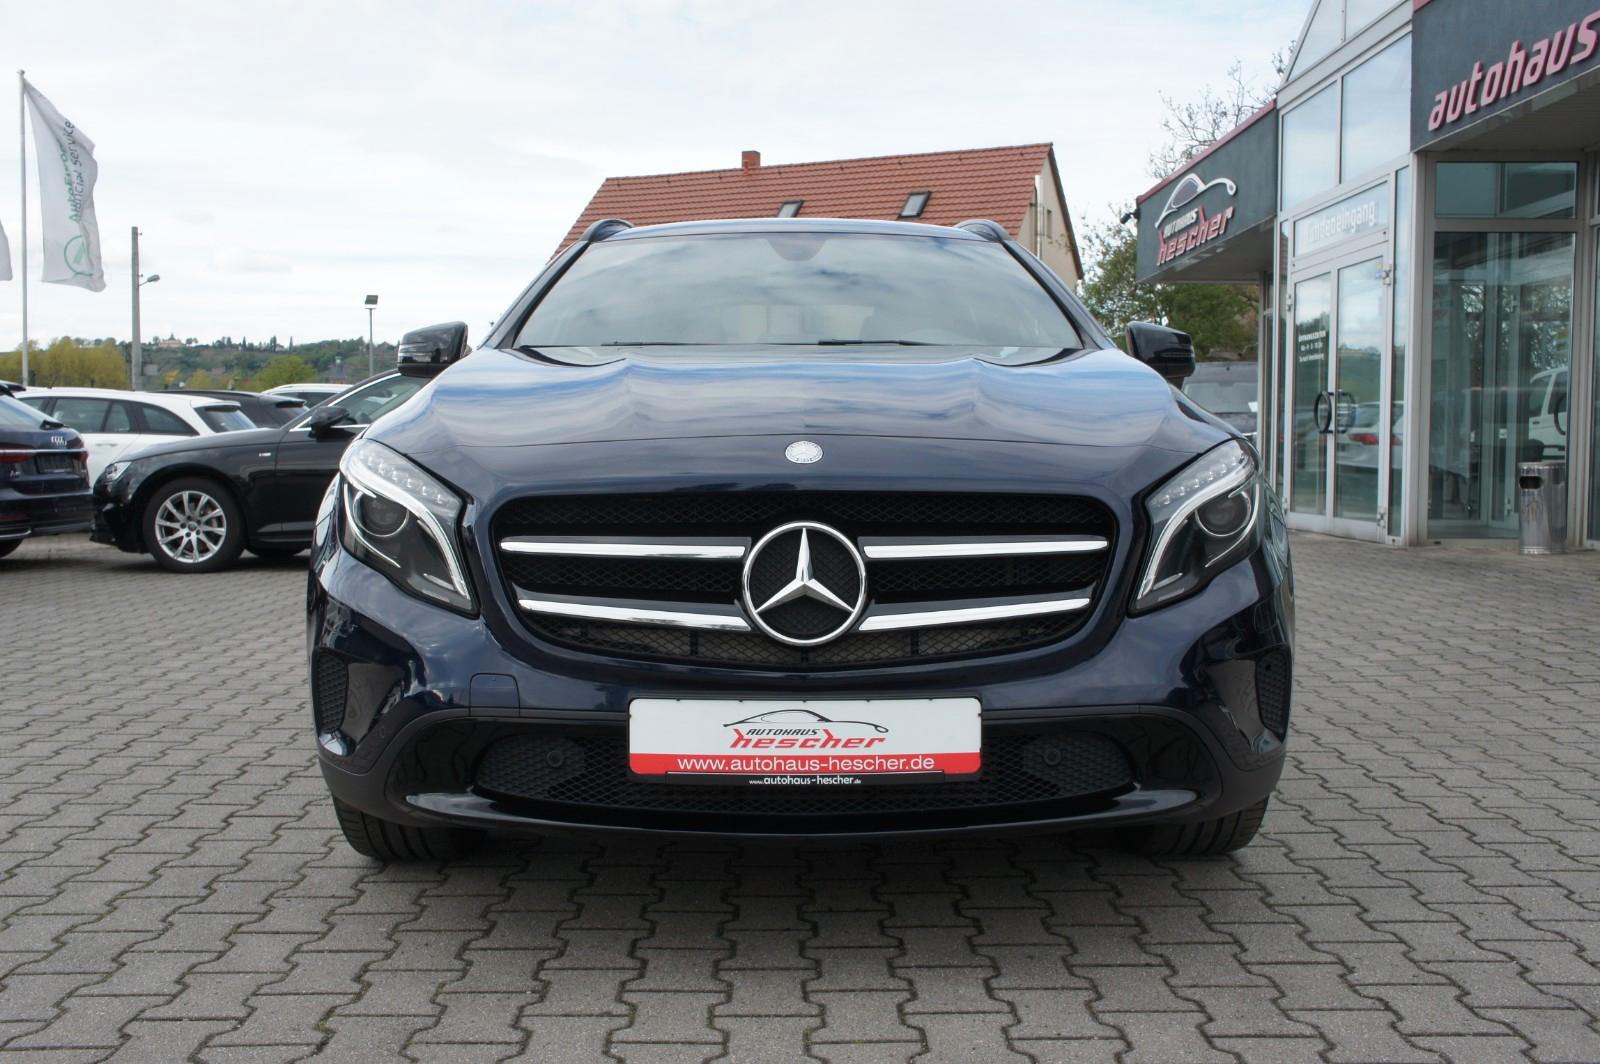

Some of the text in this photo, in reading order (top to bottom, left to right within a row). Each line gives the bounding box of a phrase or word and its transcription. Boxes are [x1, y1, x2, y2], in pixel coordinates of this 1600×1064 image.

[1428, 11, 1600, 131] autohaus
[1156, 203, 1234, 266] hescher
[730, 729, 886, 749] hescher
[745, 728, 821, 736] AUTOHAUS
[677, 755, 935, 771] www.autohaus-hescher.de
[748, 775, 862, 785] www.autohaus-hescher.de
